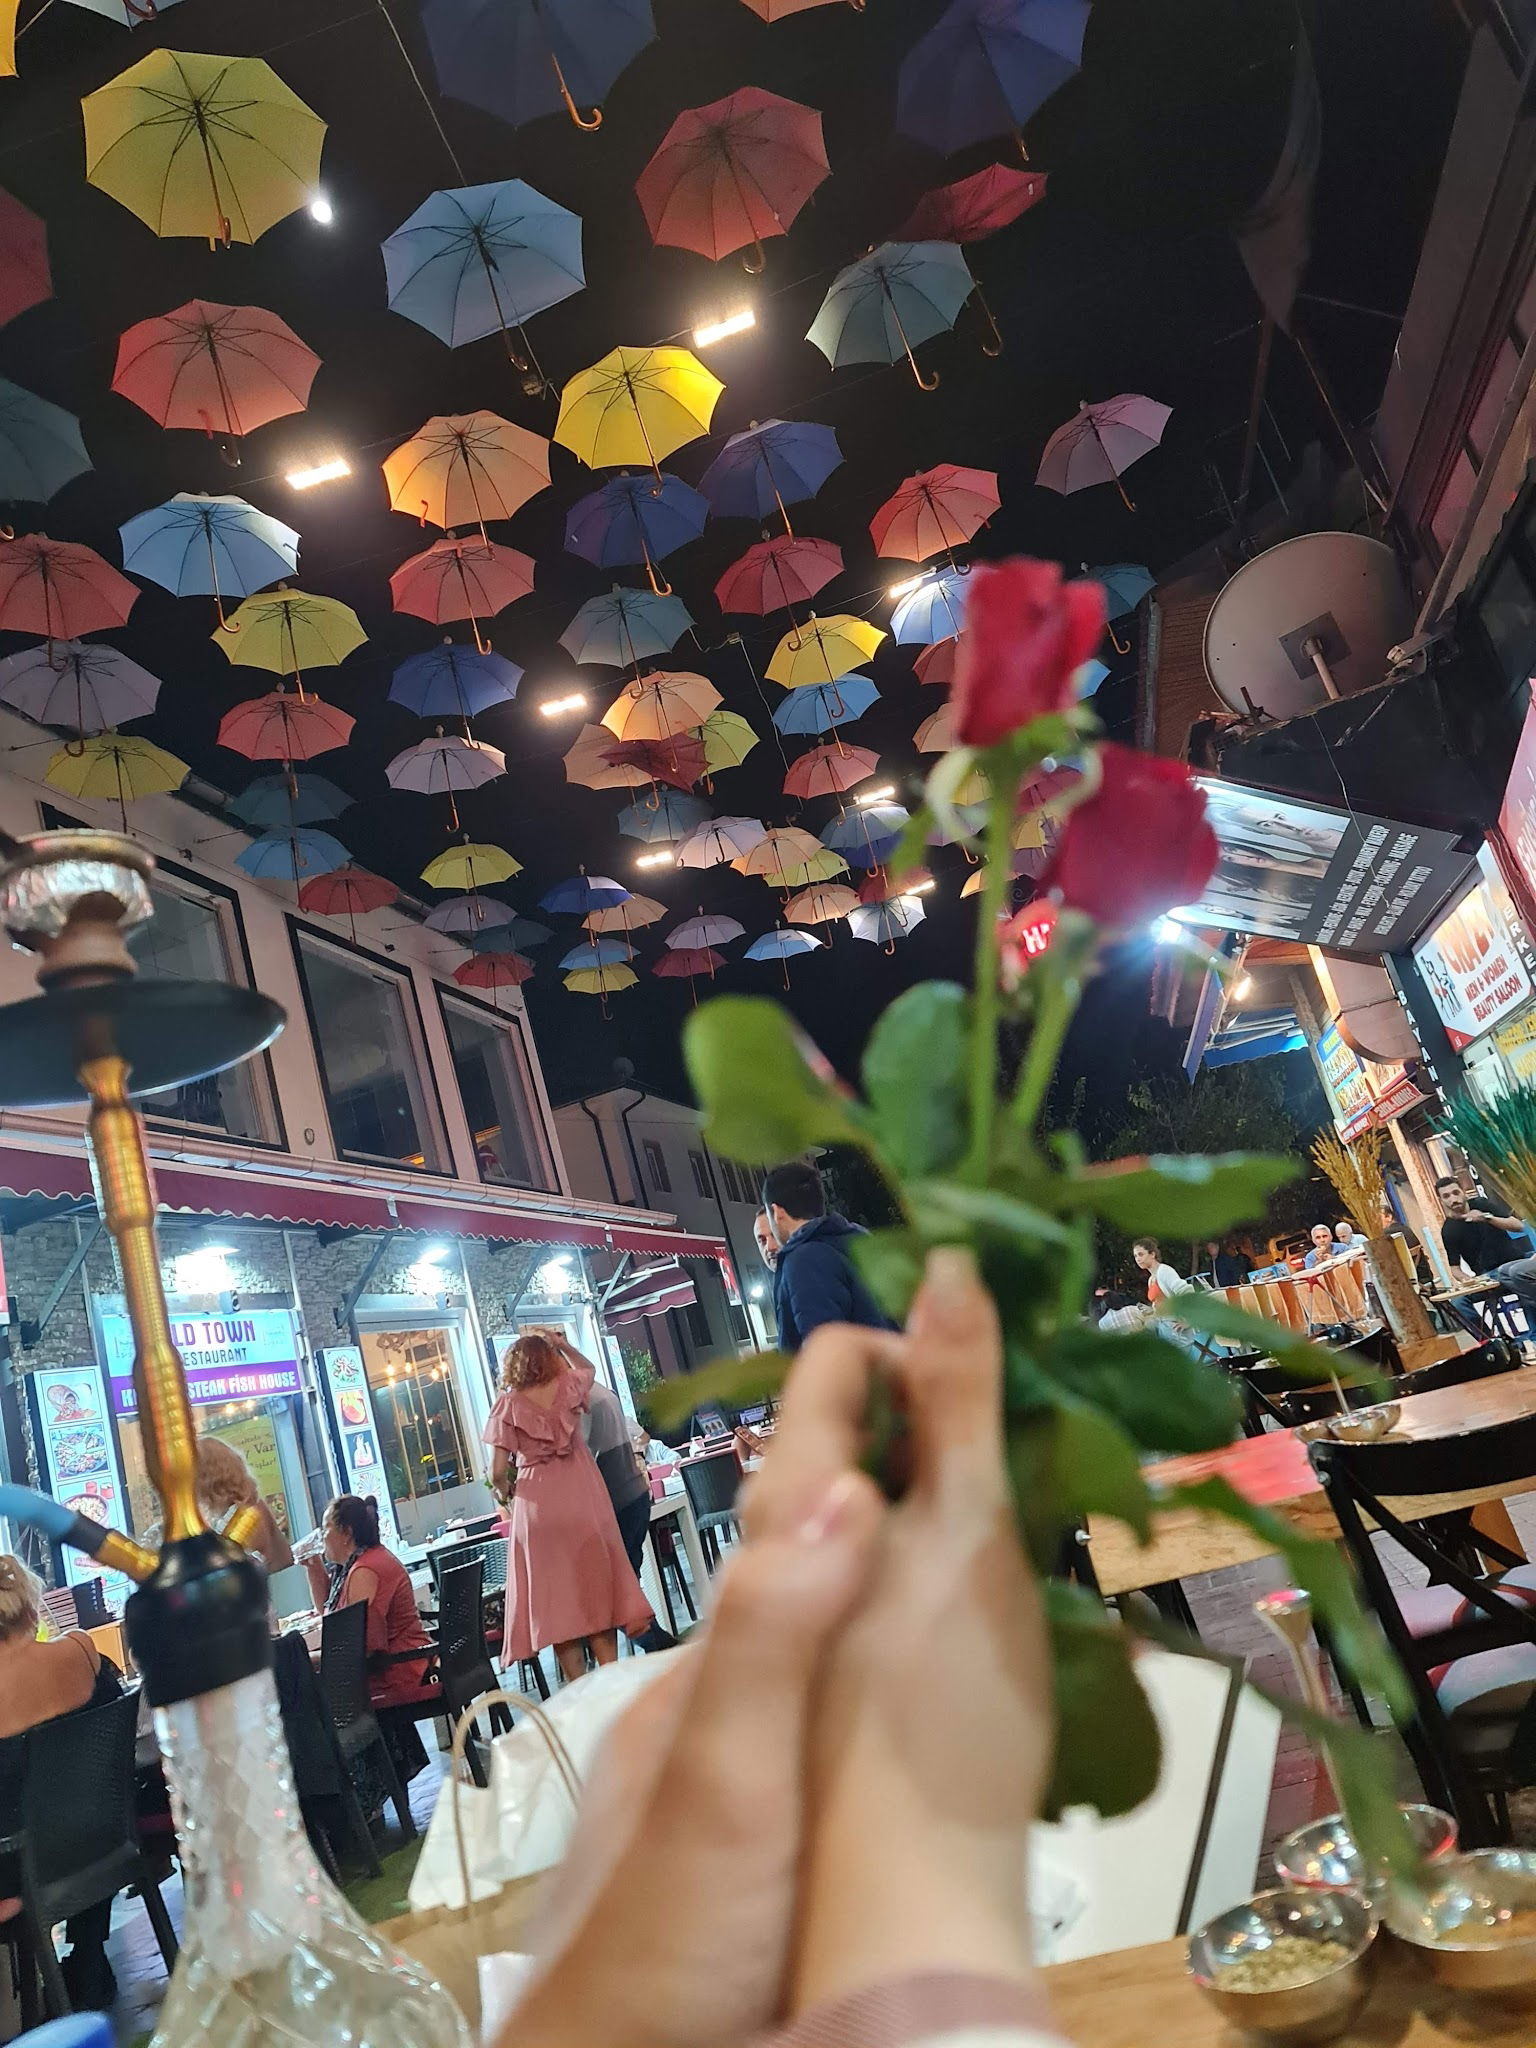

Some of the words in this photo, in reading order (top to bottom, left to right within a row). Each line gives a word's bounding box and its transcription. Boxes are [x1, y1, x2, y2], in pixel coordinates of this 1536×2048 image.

[1388, 832, 1419, 860] MASSAGE
[1465, 980, 1480, 1002] MEN
[1481, 954, 1509, 986] WOMEN
[1473, 992, 1498, 1022] BEAUTY
[1494, 972, 1523, 1005] SALOON
[1397, 990, 1439, 1082] BAYAN
[171, 1323, 195, 1347] LD
[201, 1320, 256, 1344] TOWN
[183, 1347, 248, 1367] ESTAURANT
[188, 1379, 226, 1399] STEAK
[259, 1371, 296, 1391] HOUSE
